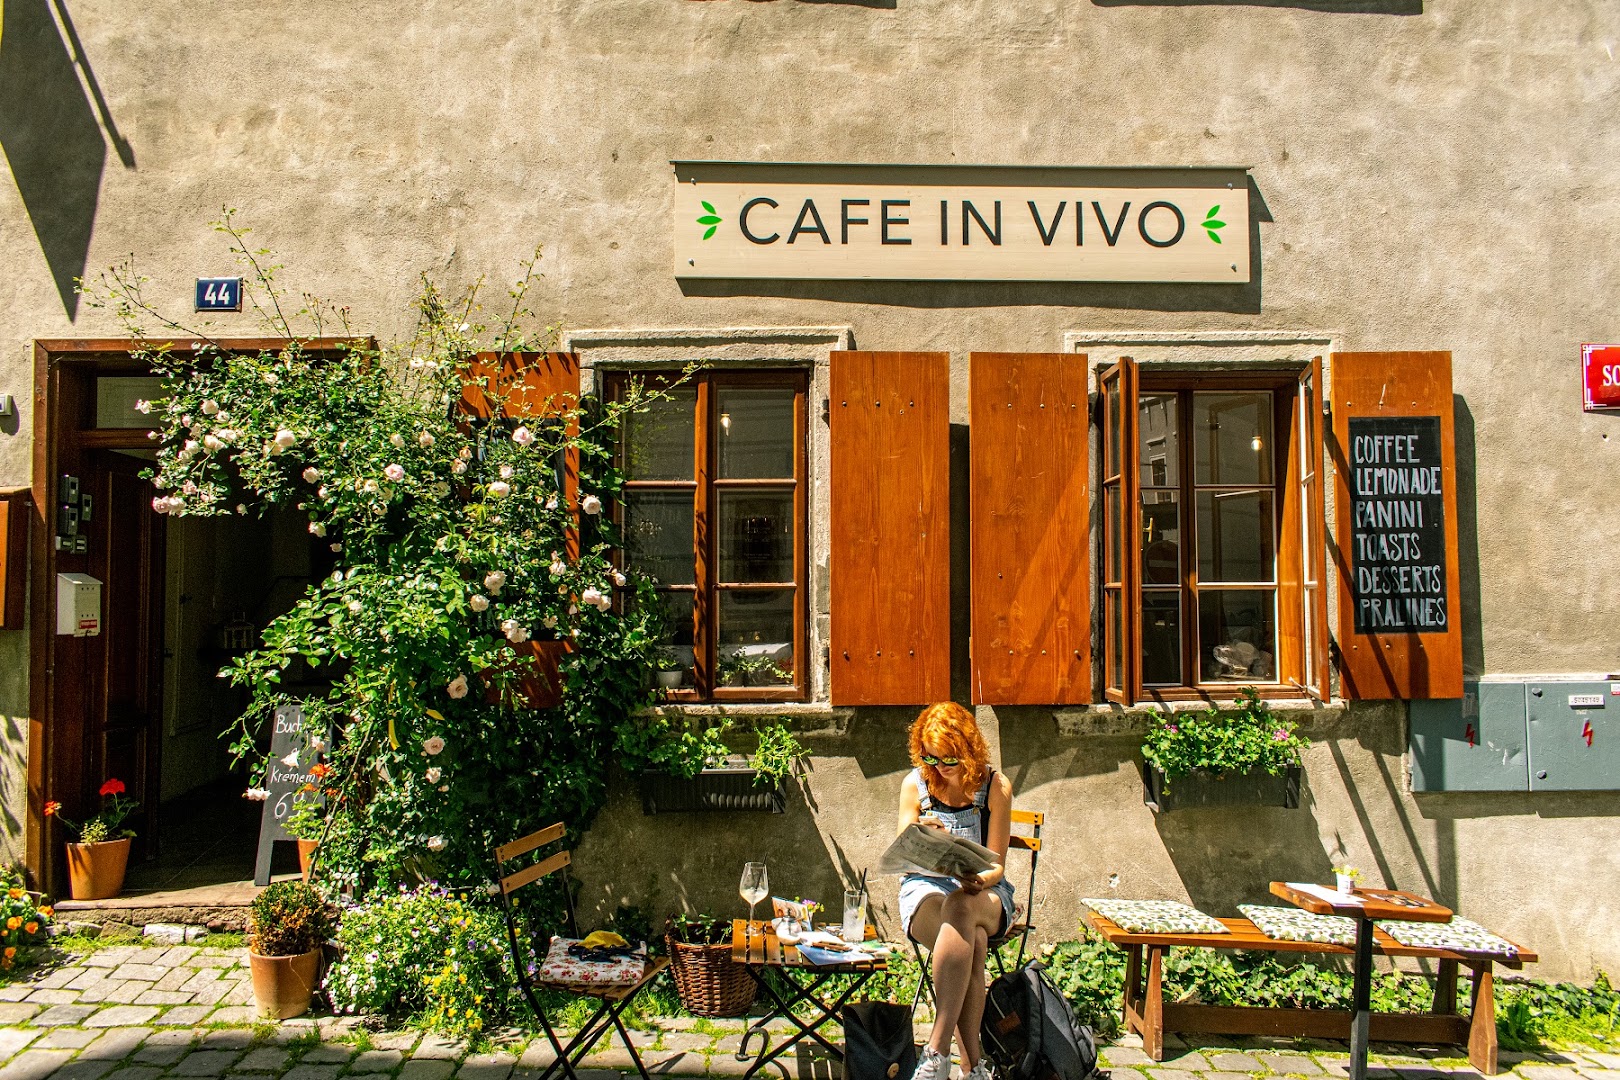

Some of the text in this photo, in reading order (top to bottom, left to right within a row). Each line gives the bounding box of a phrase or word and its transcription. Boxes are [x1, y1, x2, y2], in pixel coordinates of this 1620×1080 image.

[738, 197, 1186, 248] CAFE IN VIVO
[204, 283, 230, 305] 44
[1354, 435, 1420, 463] COFFEE
[1356, 466, 1441, 496] LEMONADE
[1356, 500, 1423, 528] PANINI
[1356, 532, 1421, 562] TOASTS
[1358, 565, 1441, 594] DESSERTS
[1360, 597, 1446, 627] PRALINES
